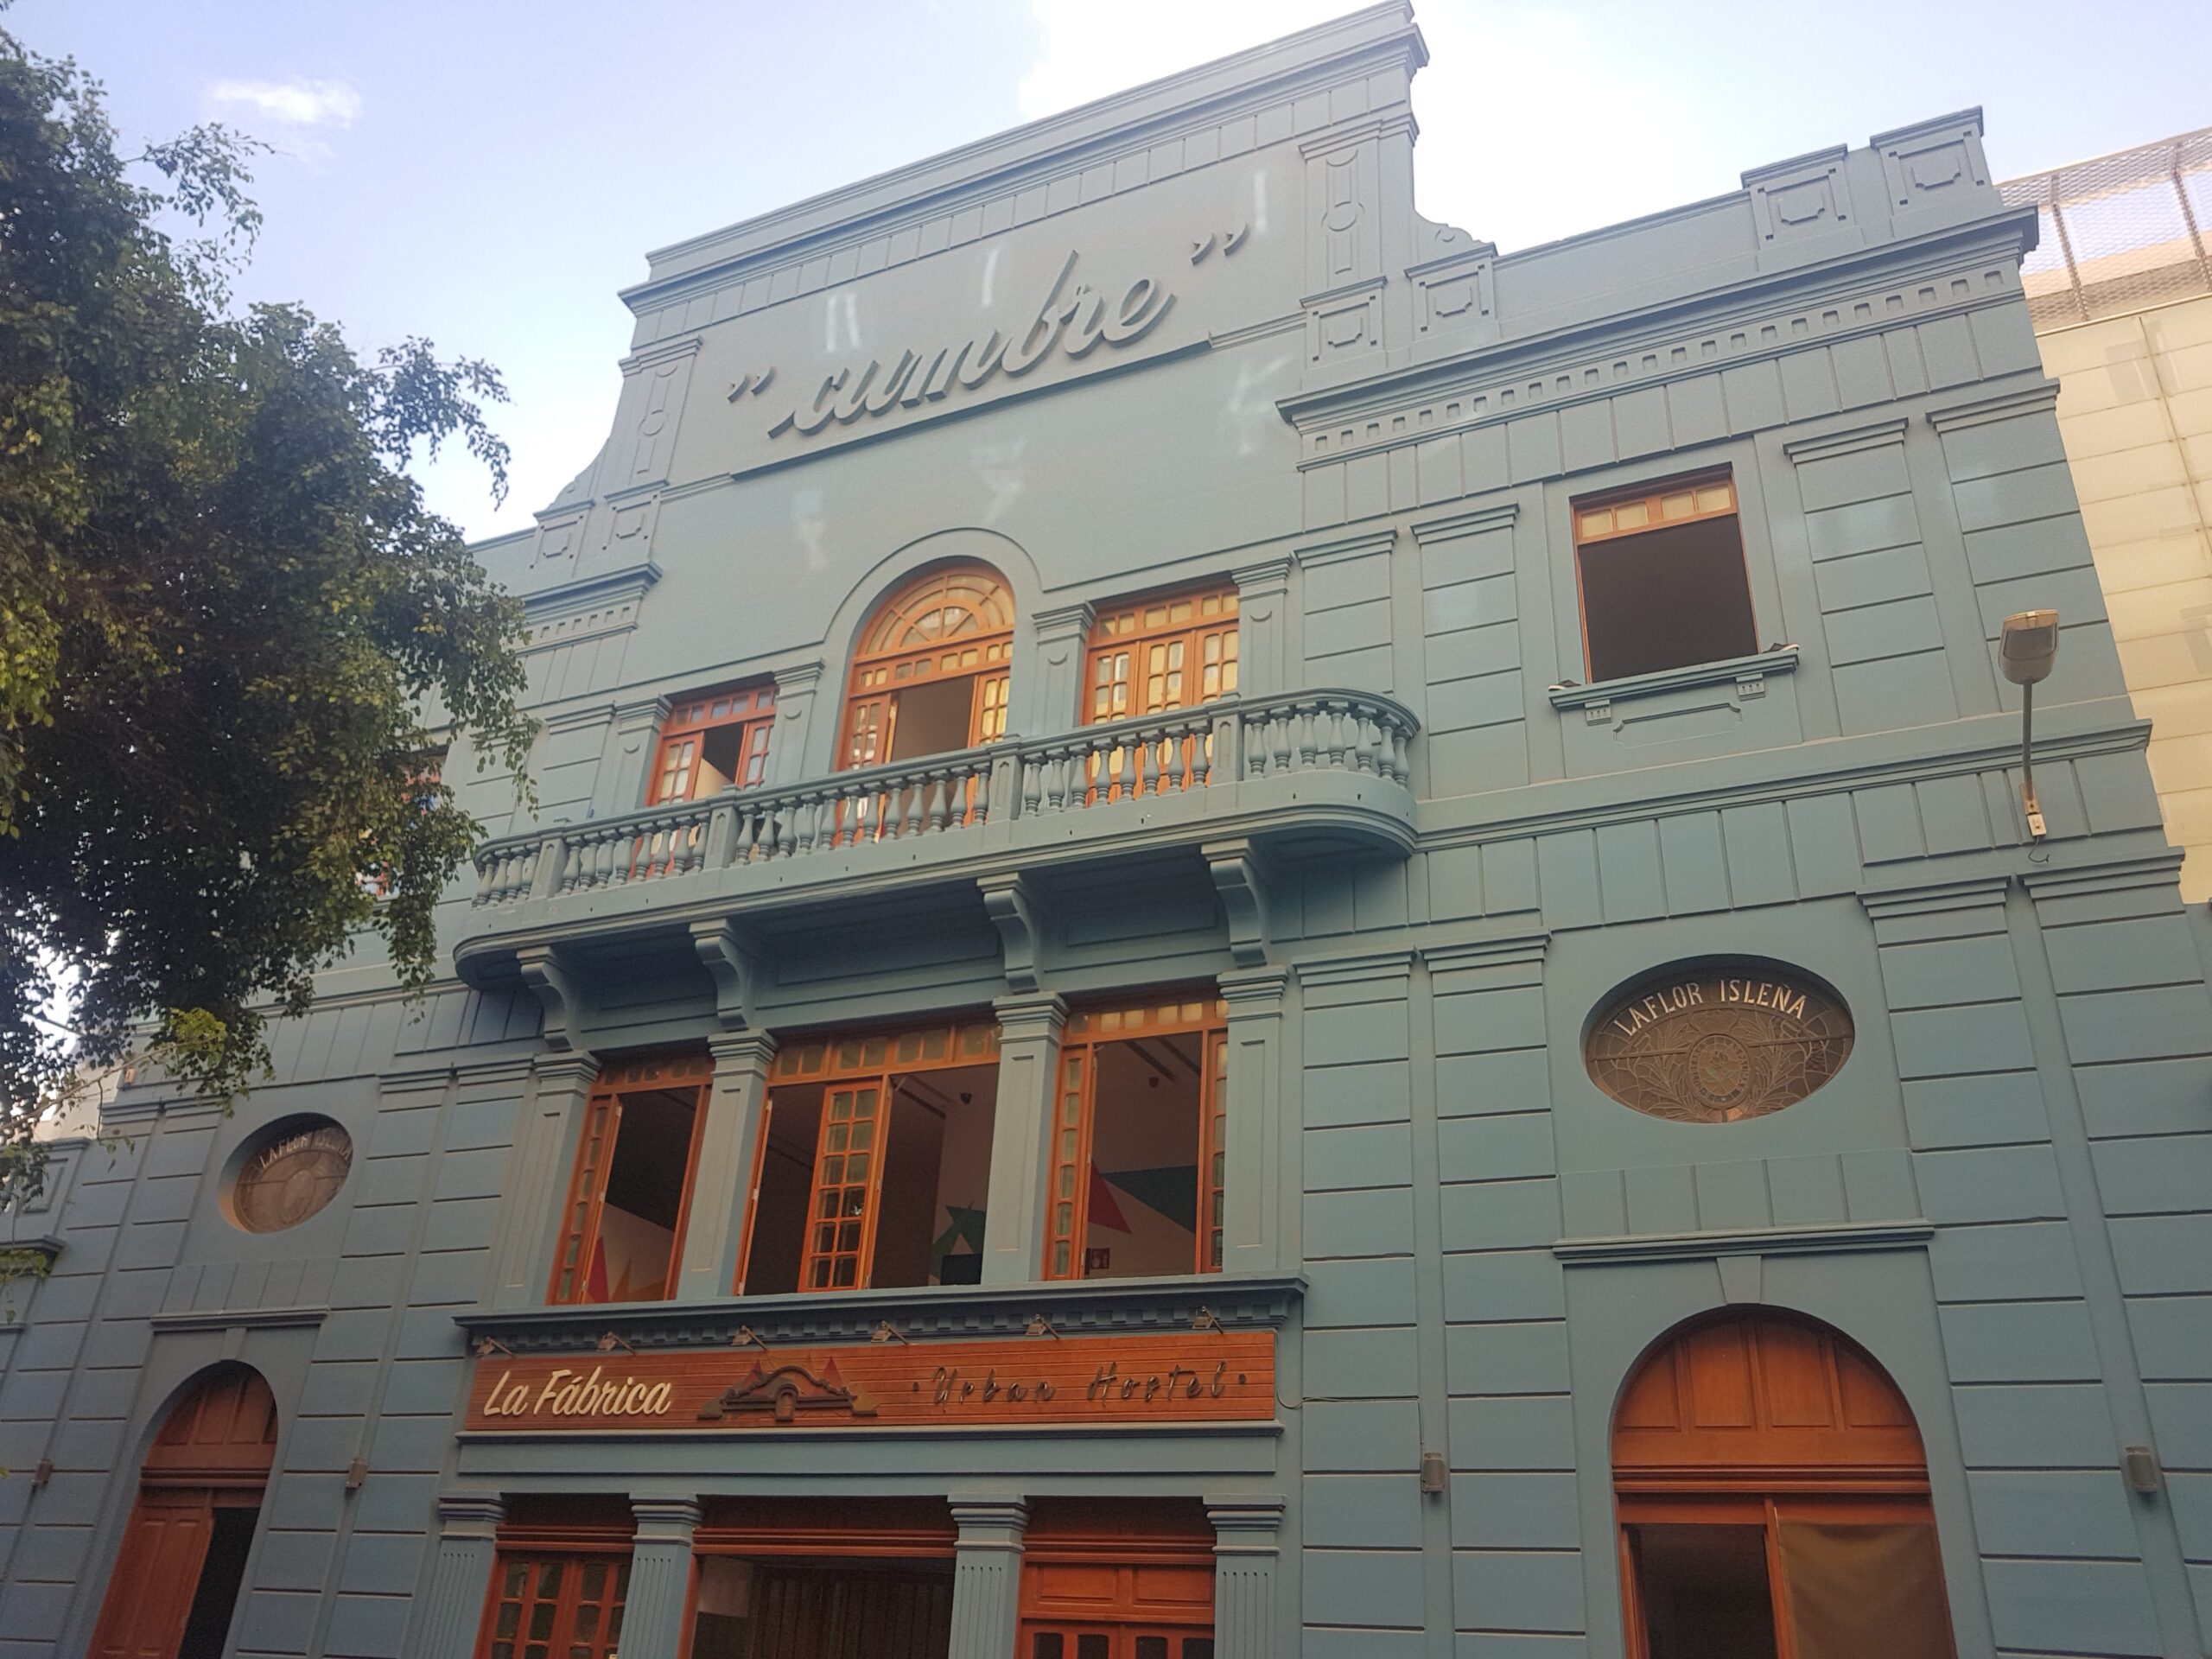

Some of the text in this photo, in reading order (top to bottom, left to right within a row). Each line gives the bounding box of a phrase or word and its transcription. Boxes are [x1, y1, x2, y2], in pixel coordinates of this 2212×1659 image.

[484, 1365, 673, 1419] La Fábrica
[932, 1360, 1227, 1413] Urban Hostel
